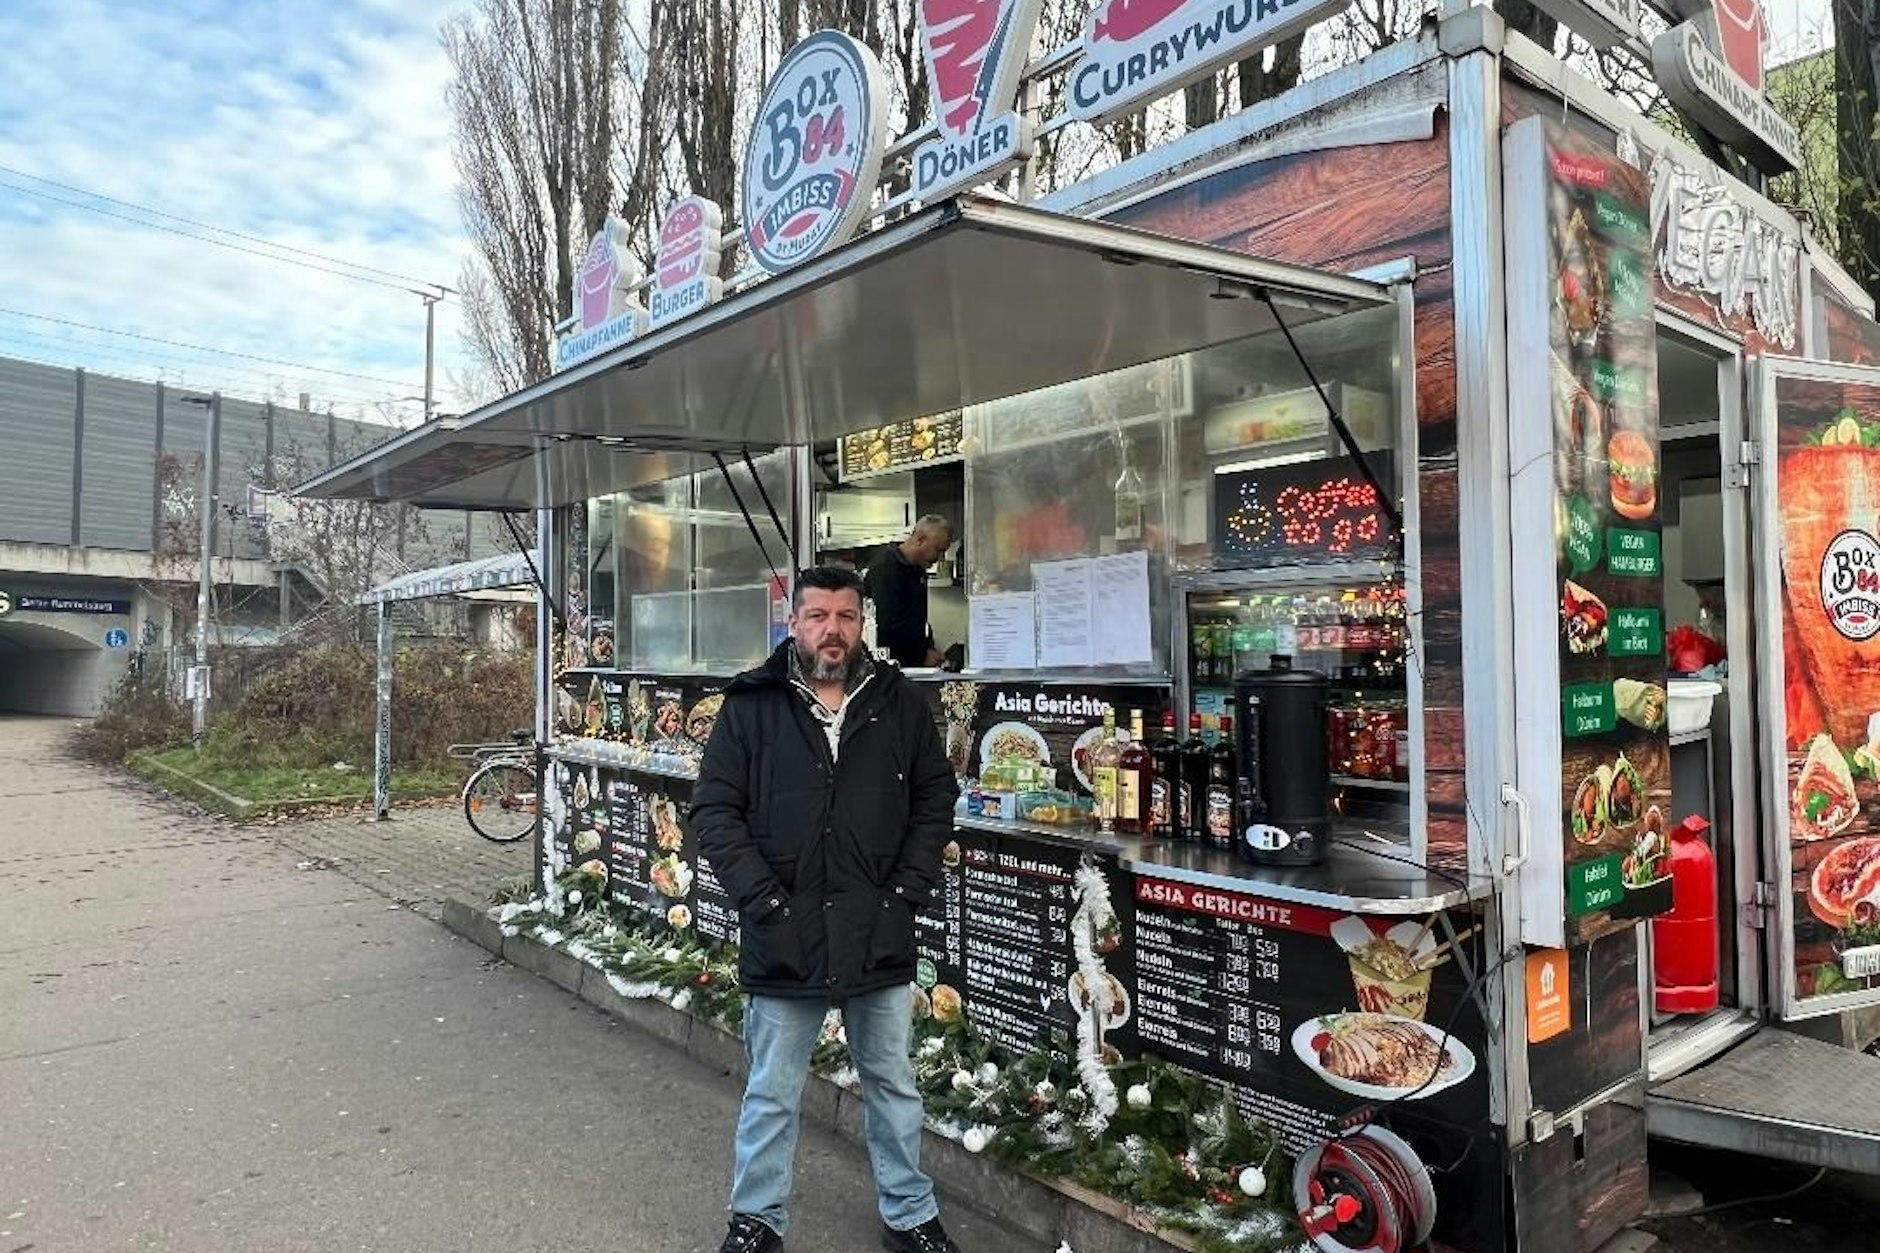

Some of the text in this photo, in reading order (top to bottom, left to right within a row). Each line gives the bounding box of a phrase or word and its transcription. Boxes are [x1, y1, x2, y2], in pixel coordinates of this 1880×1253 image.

[802, 104, 845, 165] 84
[919, 123, 1010, 190] DÖNER
[770, 180, 833, 231] IMBISS
[652, 280, 705, 318] BURGER
[1839, 599, 1877, 617] IMBISS
[995, 691, 1031, 712] Asia
[1140, 883, 1292, 925] ASIA GERICHTE
[1135, 949, 1173, 969] Nudeln
